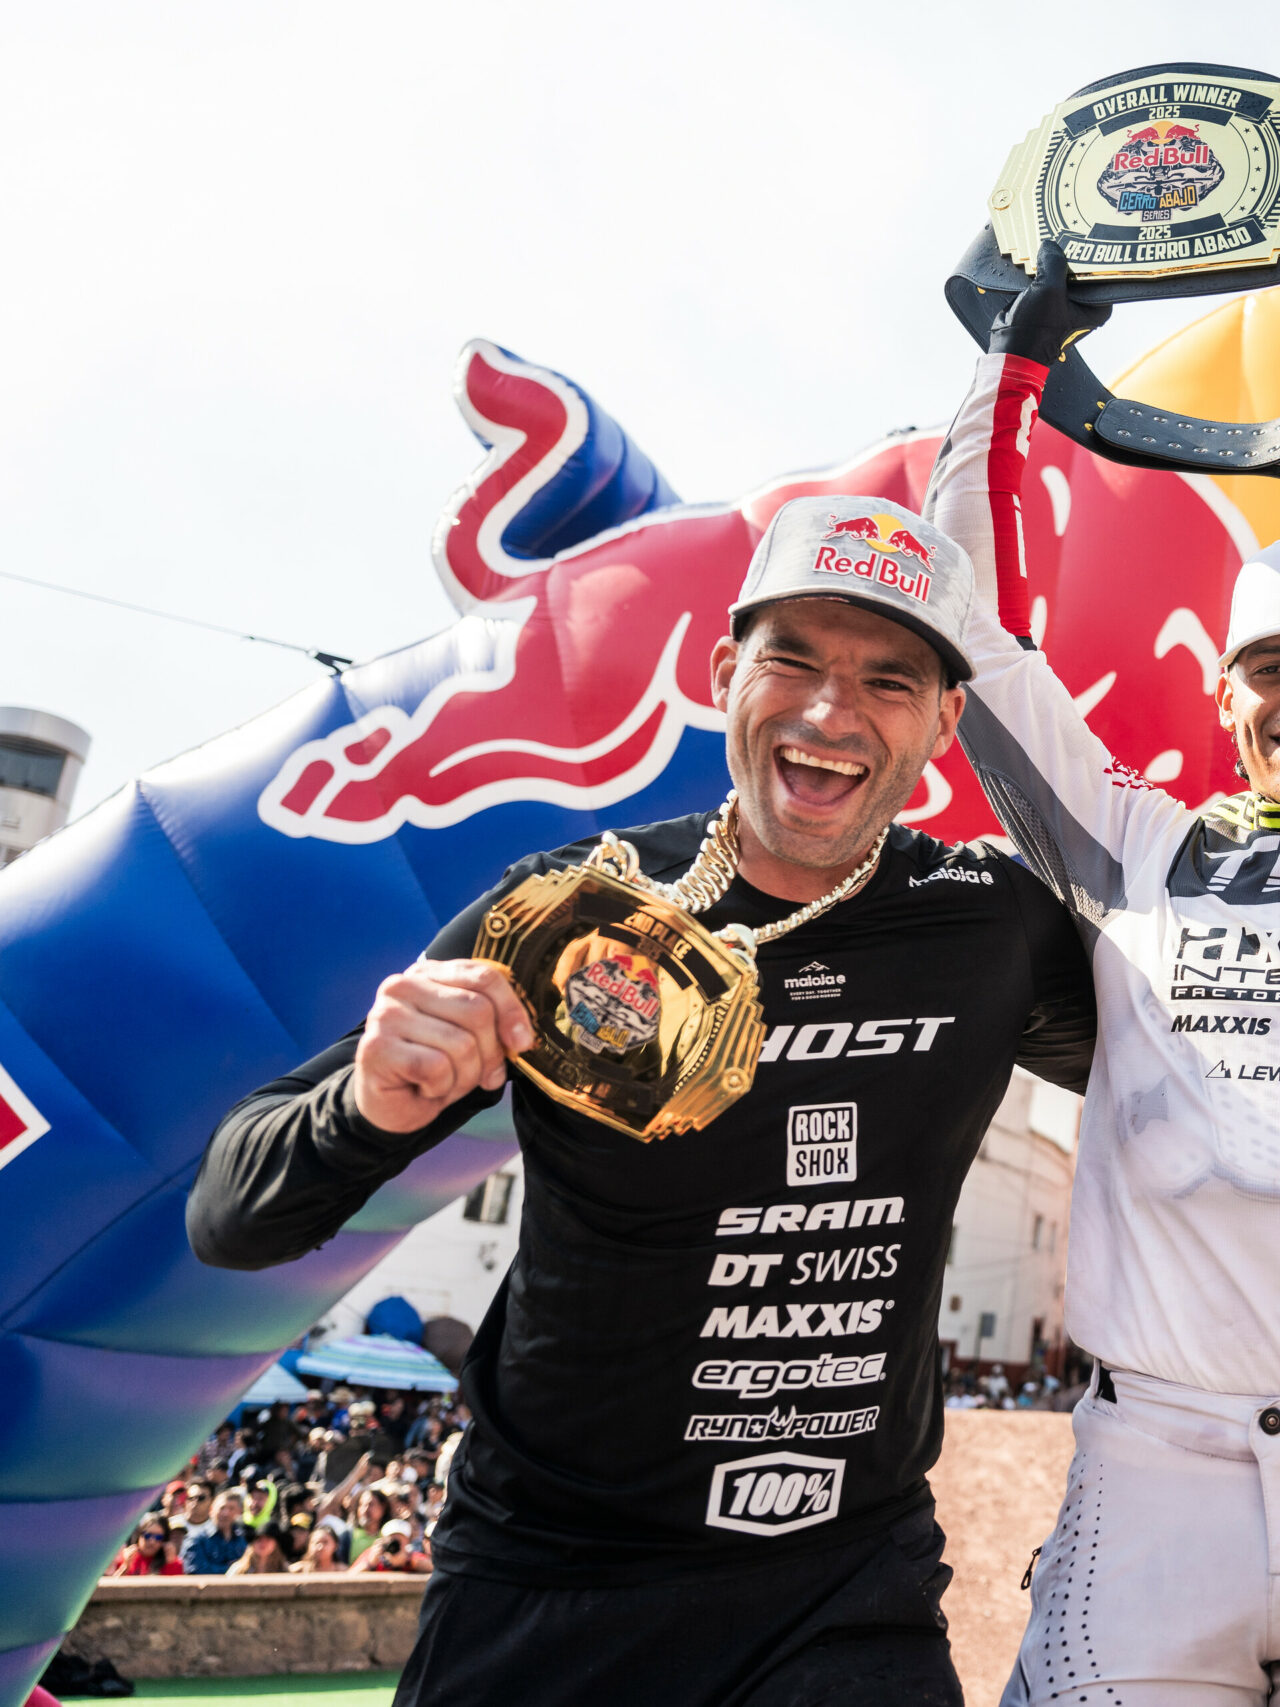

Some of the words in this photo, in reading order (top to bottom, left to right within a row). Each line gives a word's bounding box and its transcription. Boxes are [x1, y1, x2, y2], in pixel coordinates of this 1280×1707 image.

[1093, 85, 1168, 120] OVERALL
[1173, 84, 1242, 108] WINNER
[1148, 105, 1180, 119] 2025
[1114, 148, 1160, 171] Red
[1163, 145, 1209, 165] Bull
[1119, 191, 1157, 211] CERRO
[1159, 186, 1197, 208] ABAJO
[1143, 209, 1170, 221] SERIES
[1065, 240, 1091, 262] RED
[1092, 244, 1133, 263] BULL
[1135, 239, 1191, 260] CERRO
[1193, 226, 1253, 255] ABAJO
[1138, 226, 1171, 240] 2025
[814, 546, 877, 579] Red
[878, 558, 931, 603] Bull
[908, 866, 981, 887] maloja
[623, 911, 656, 934] 2ND
[650, 921, 693, 961] PLACE
[587, 962, 626, 996] Red
[621, 984, 660, 1018] Bull
[784, 973, 836, 989] maloja
[757, 1017, 956, 1063] HOST
[1170, 1014, 1272, 1036] MAXXIS
[795, 1109, 850, 1143] ROCK
[795, 1147, 850, 1178] SHOX
[707, 1253, 784, 1288] DT
[789, 1244, 902, 1285] SWISS
[696, 1354, 885, 1397] ergotec
[788, 1408, 878, 1438] POWER
[729, 1472, 834, 1517] 100%
